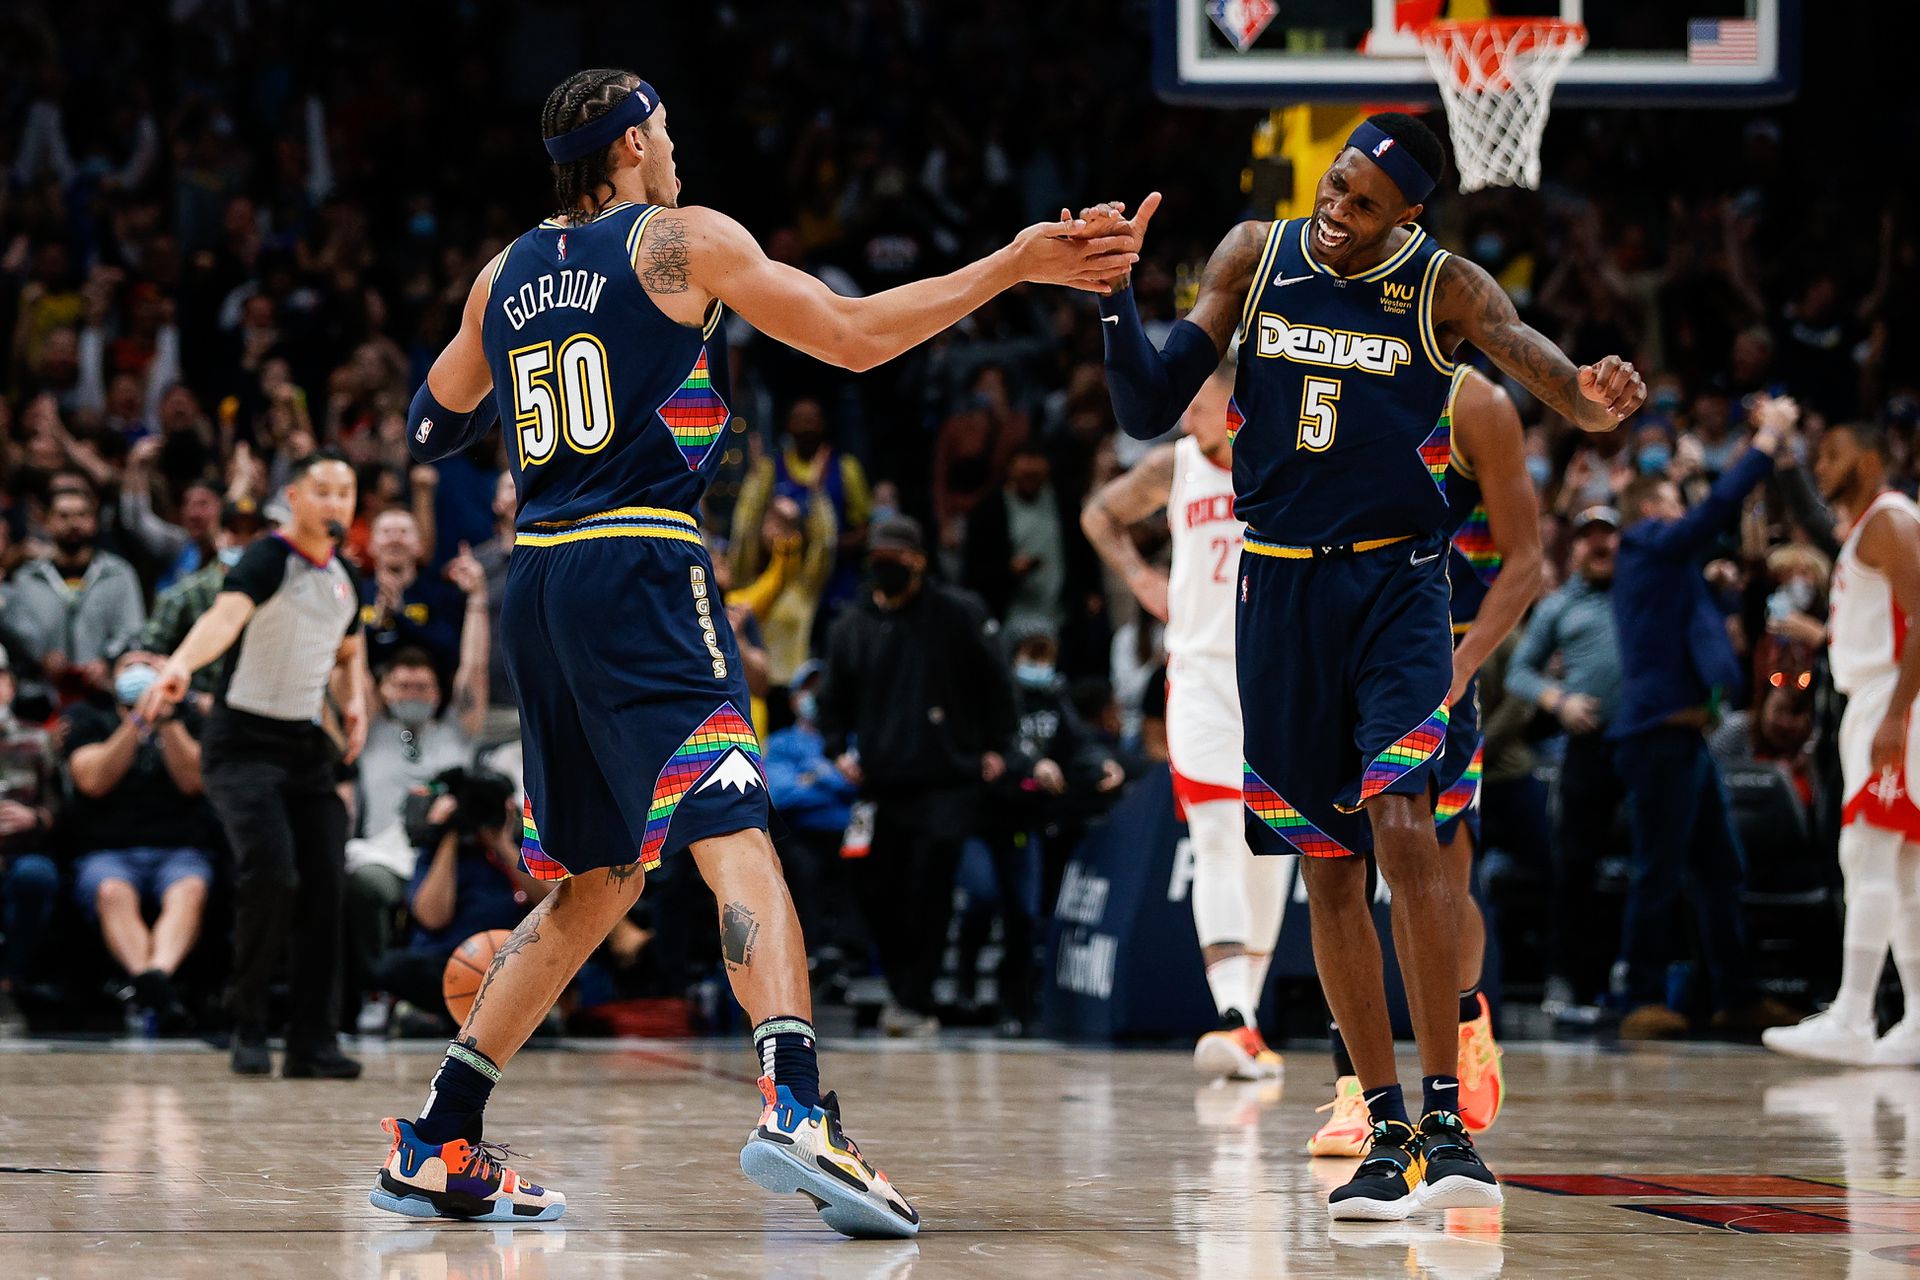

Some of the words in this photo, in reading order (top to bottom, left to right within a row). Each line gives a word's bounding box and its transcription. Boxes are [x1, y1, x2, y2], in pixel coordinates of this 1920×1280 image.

[503, 269, 607, 331] GORDON
[1380, 297, 1412, 309] Western
[1383, 281, 1415, 301] WU
[1383, 305, 1406, 315] Union
[1257, 311, 1412, 376] Denver
[508, 332, 616, 472] 50
[1296, 375, 1342, 453] 5
